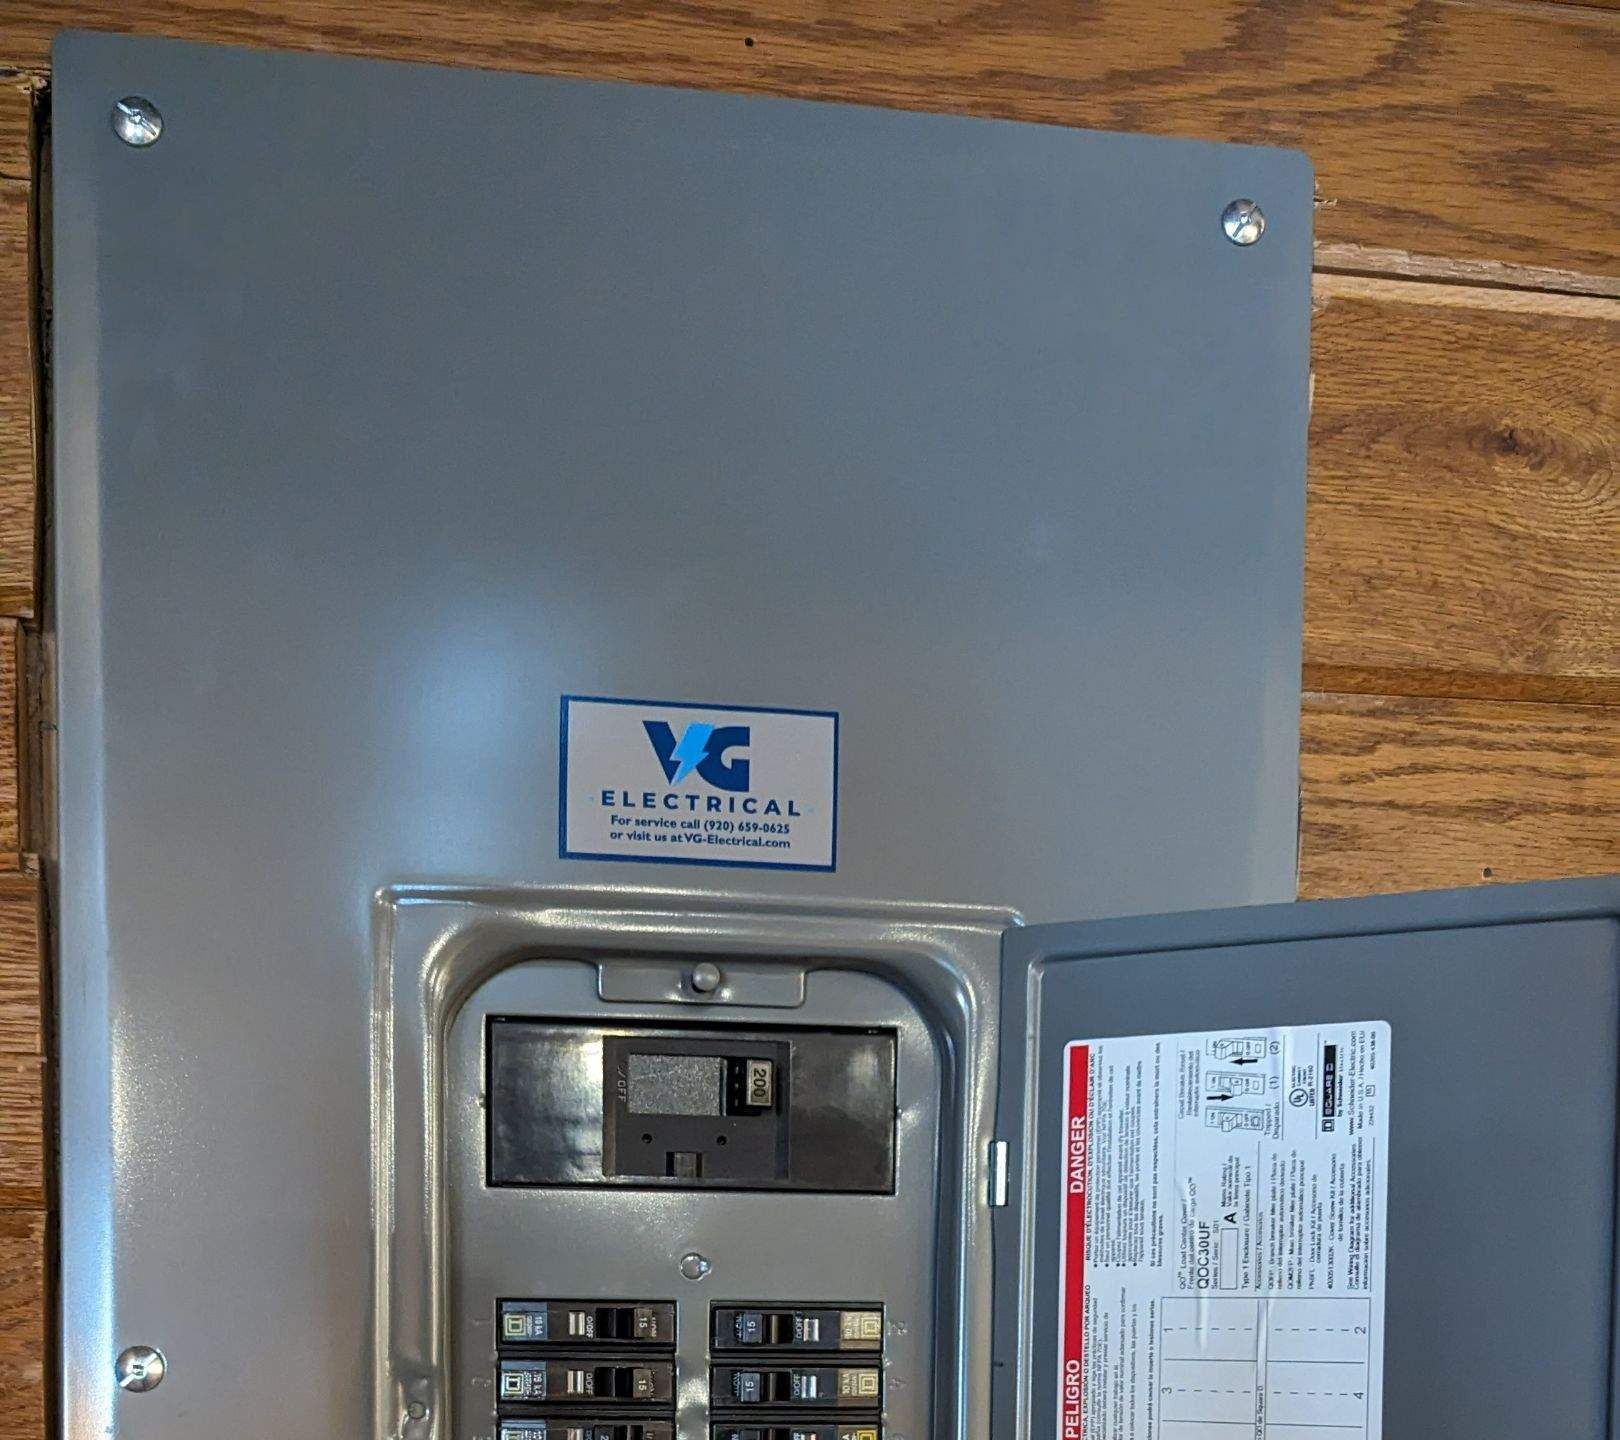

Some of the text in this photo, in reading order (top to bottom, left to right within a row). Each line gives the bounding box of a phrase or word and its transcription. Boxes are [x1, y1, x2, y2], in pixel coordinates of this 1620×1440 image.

[602, 790, 801, 817] ELECTRICAL
[611, 815, 790, 834] For service call (920) 659-0625
[610, 830, 791, 848] or visit us at VG-Electrical.com
[1270, 1041, 1279, 1054] (2)
[754, 1068, 766, 1097] 200
[1269, 1076, 1279, 1089] (1)
[1069, 1116, 1085, 1193] DANGER
[1224, 1212, 1236, 1224] A
[1197, 1222, 1209, 1289] QOC30UF
[639, 1317, 647, 1328] 15
[748, 1321, 756, 1332] 15
[639, 1379, 646, 1391] 15
[745, 1381, 754, 1392] 15
[1065, 1359, 1080, 1439] PELIGRO
[1353, 1392, 1364, 1400] 4
